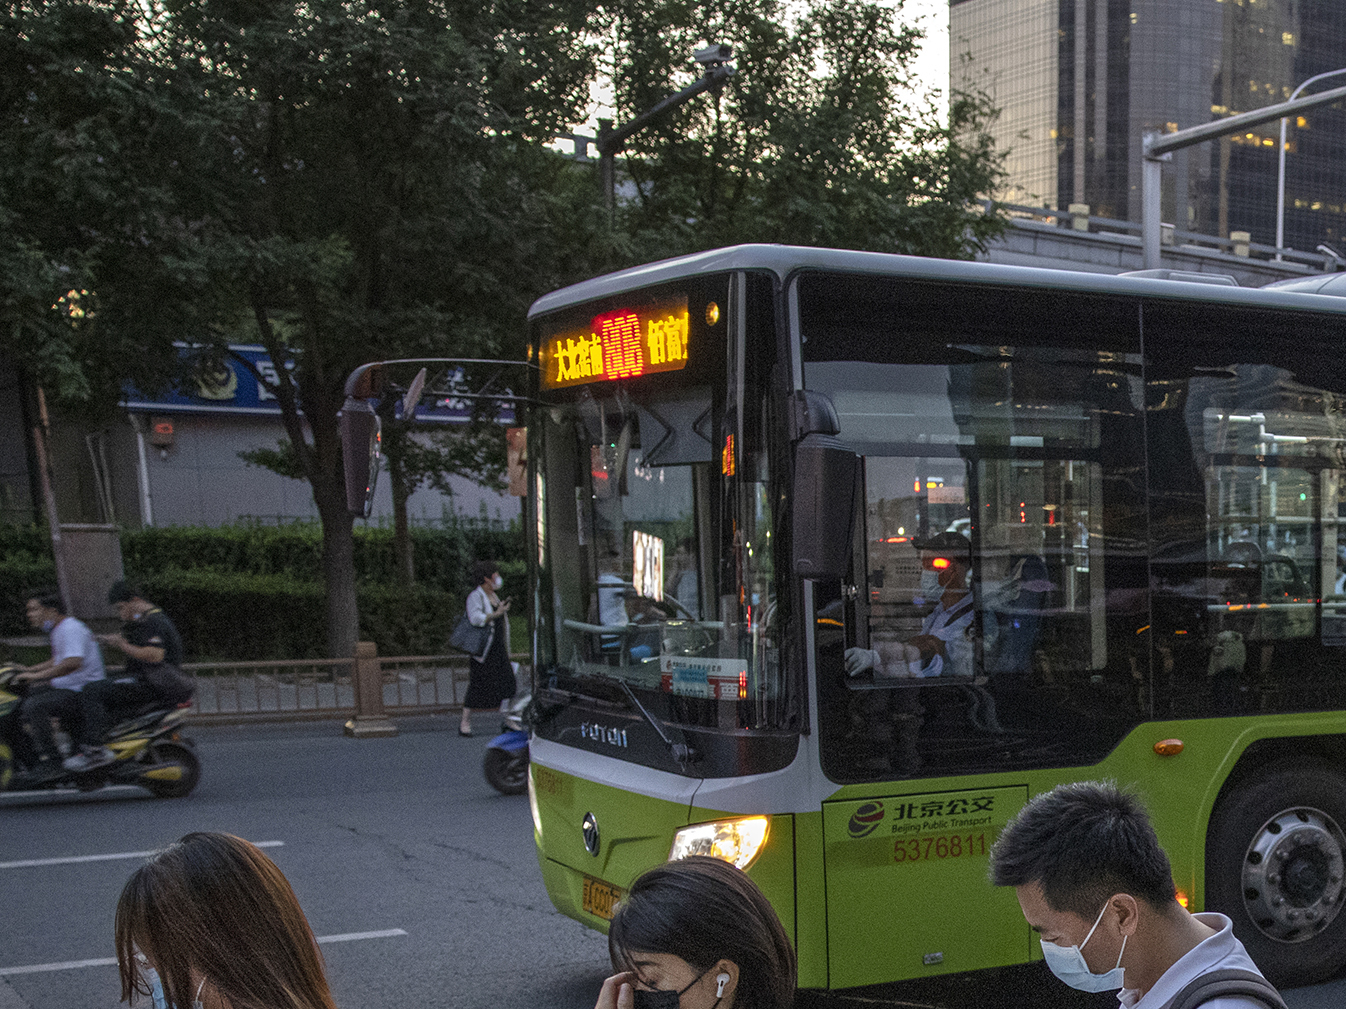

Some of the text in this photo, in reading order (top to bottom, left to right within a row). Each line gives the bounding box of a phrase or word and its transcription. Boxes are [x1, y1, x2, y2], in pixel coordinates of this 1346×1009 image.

[893, 796, 995, 821] 北京公交
[892, 816, 992, 834] Beijing Public Transport
[893, 833, 986, 863] 5376811
